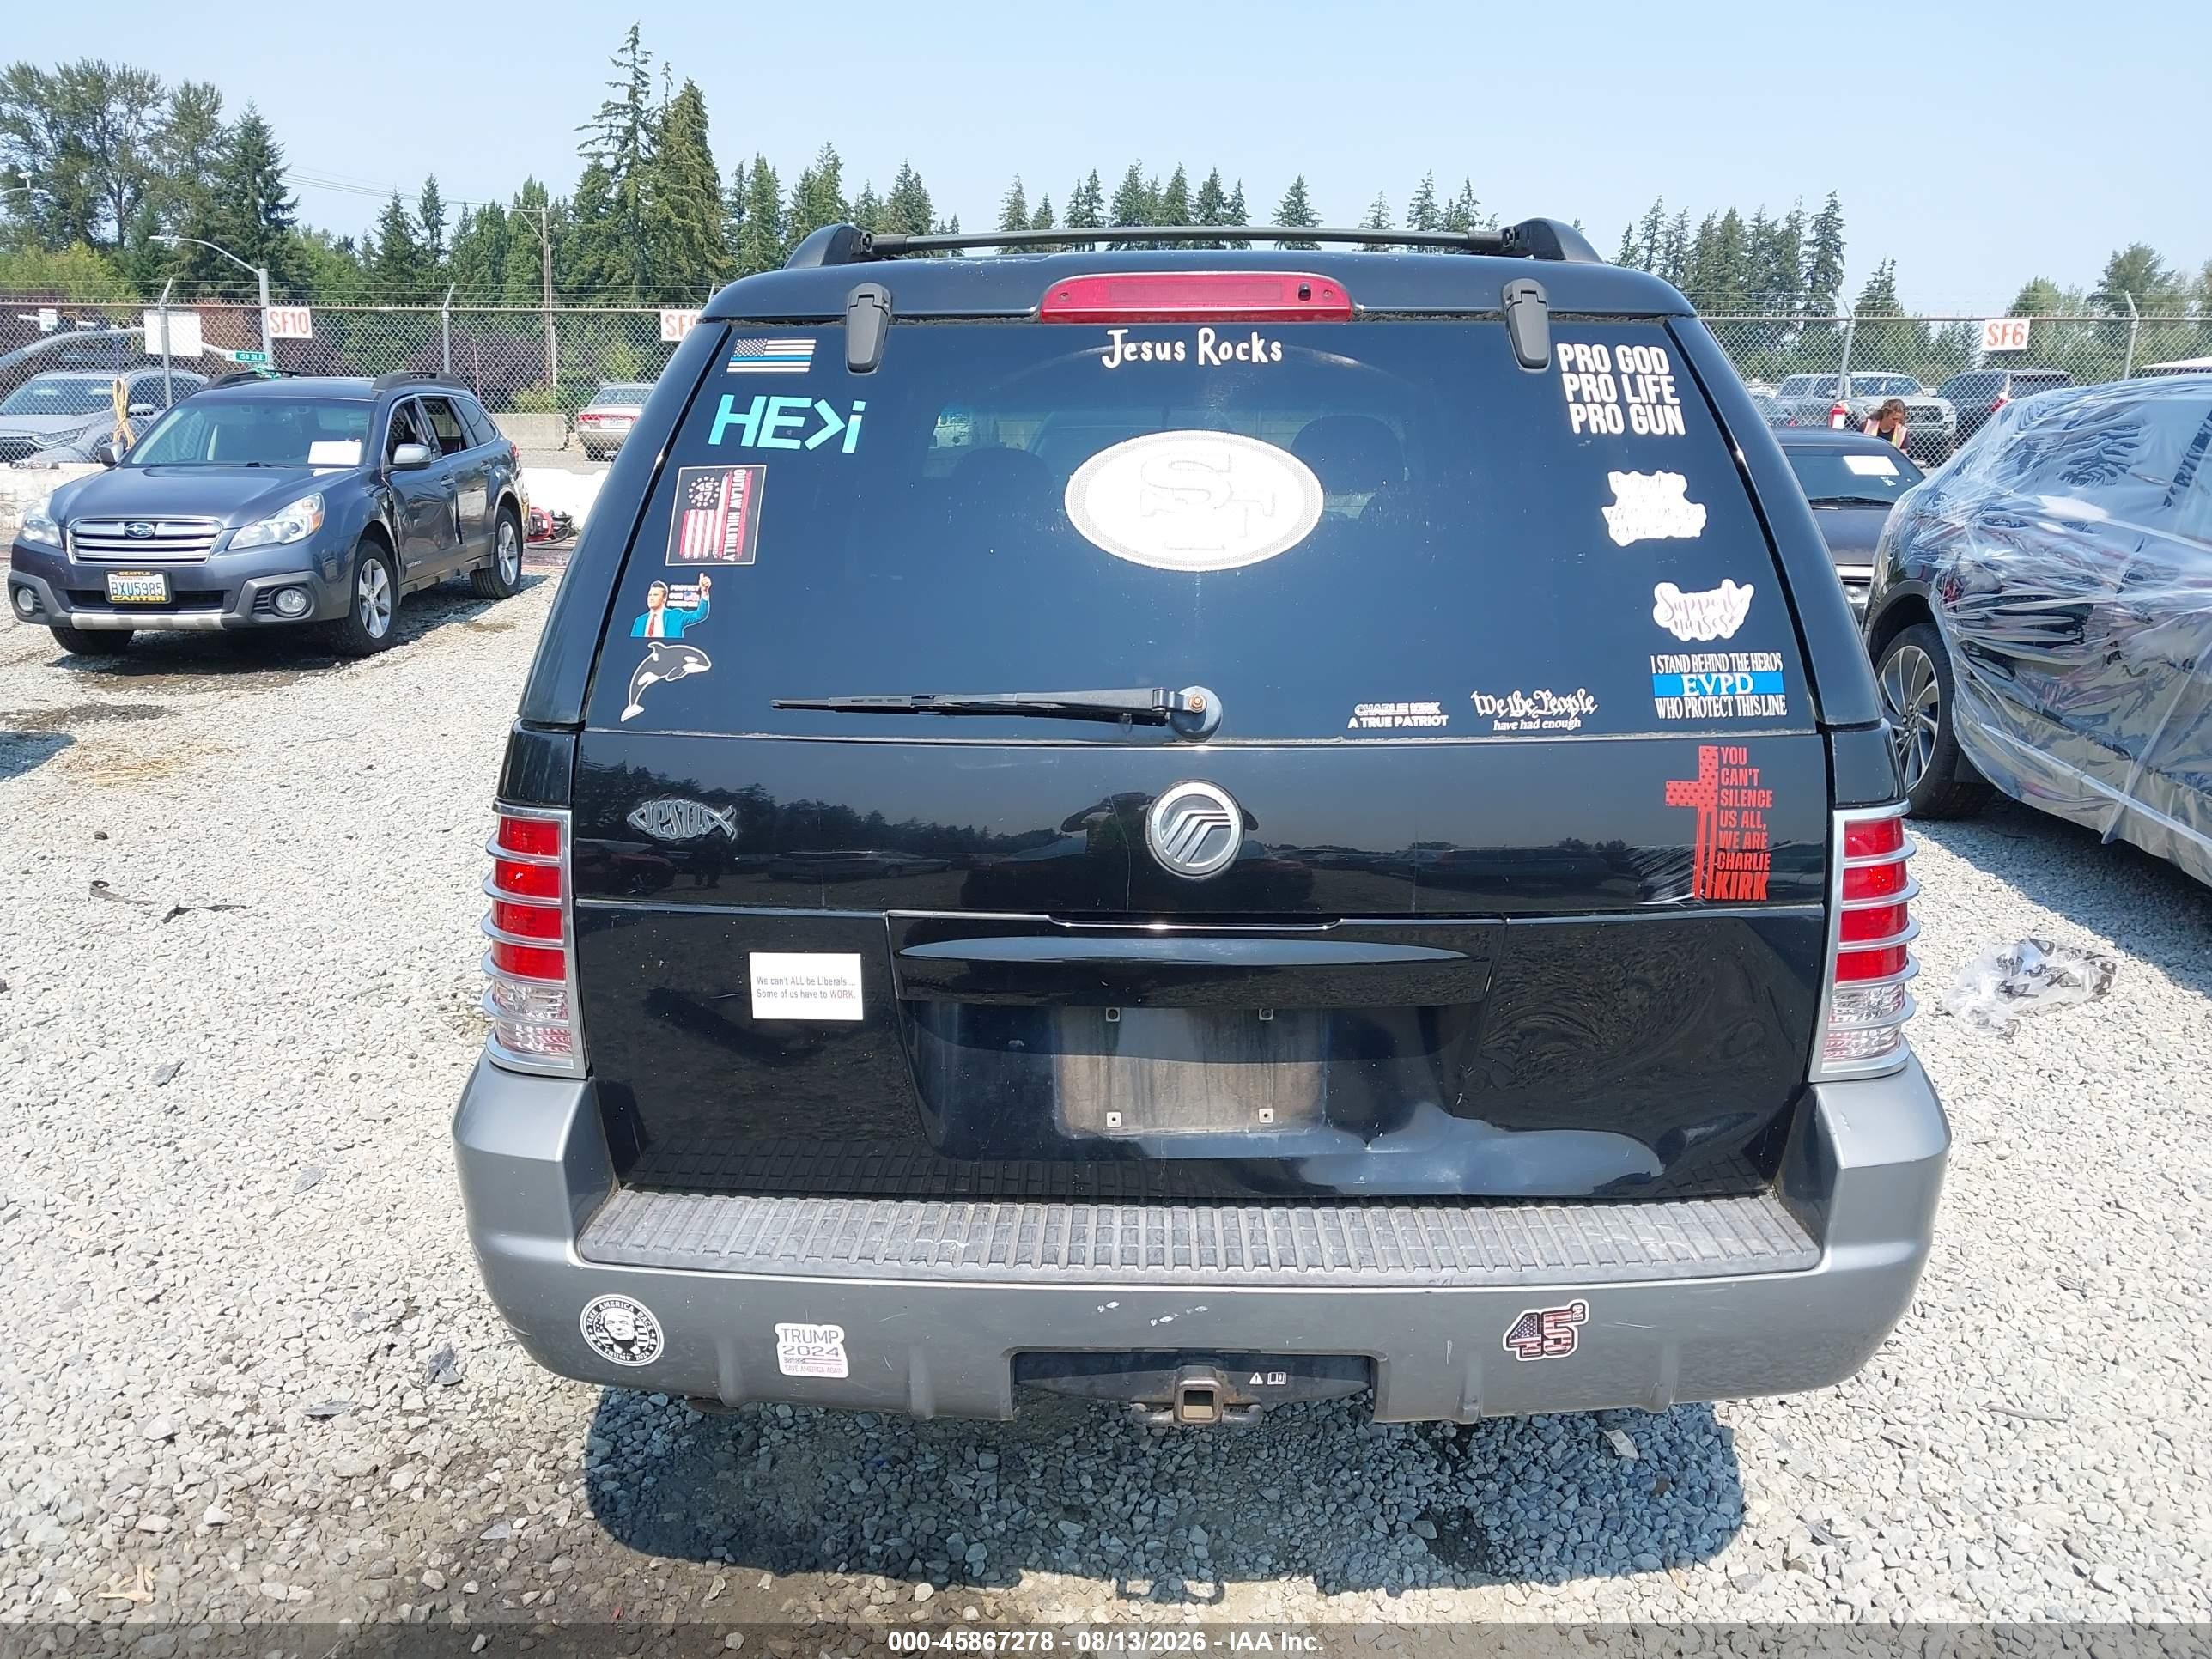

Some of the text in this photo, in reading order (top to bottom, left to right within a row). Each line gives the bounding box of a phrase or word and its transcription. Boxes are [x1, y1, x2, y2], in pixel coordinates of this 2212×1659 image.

[269, 310, 310, 335] SF10
[1986, 322, 2025, 347] SF6
[1101, 327, 1283, 368] Jesus Rocks
[1556, 343, 1670, 374] PRO GOD
[1562, 372, 1680, 404] PRO LIFE
[1568, 403, 1686, 436] PRO GUN
[694, 491, 713, 501] 47
[695, 482, 714, 492] 45
[722, 469, 747, 562] OUTLAW HILLBILLY
[1659, 585, 1741, 622] Support
[1650, 652, 1784, 675] I STAND BEHIND THE HEROS
[1681, 672, 1754, 696] EVPD
[1354, 702, 1441, 716] CHARLIE KIRK
[1470, 690, 1510, 718] We
[1531, 687, 1599, 720] People
[1654, 694, 1788, 720] WHO PROTECT THIS LINE
[1347, 714, 1449, 729] A TRUE PATRIOT
[1492, 717, 1582, 731] have had enough
[1720, 746, 1748, 765] YOU
[1720, 768, 1759, 787] CAN'T
[1720, 789, 1773, 809] SILENCE
[1719, 810, 1767, 830] US ALL,
[1718, 830, 1768, 850] WE ARE
[1717, 851, 1771, 871] CHARLIE
[1714, 871, 1770, 901] KIRK
[757, 975, 769, 986] We
[770, 975, 789, 986] can't
[790, 975, 805, 986] ALL
[806, 975, 816, 987] be
[817, 975, 848, 987] Liberals
[757, 988, 778, 999] Some
[780, 988, 788, 999] of
[789, 990, 799, 999] us
[800, 989, 818, 999] have
[820, 989, 828, 999] to
[586, 1300, 654, 1331] TAKE AMERICA BACK
[781, 1328, 839, 1345] TRUMP
[604, 1347, 632, 1361] TRUMP
[782, 1345, 839, 1358] 2024
[799, 1364, 825, 1374] AMERICA
